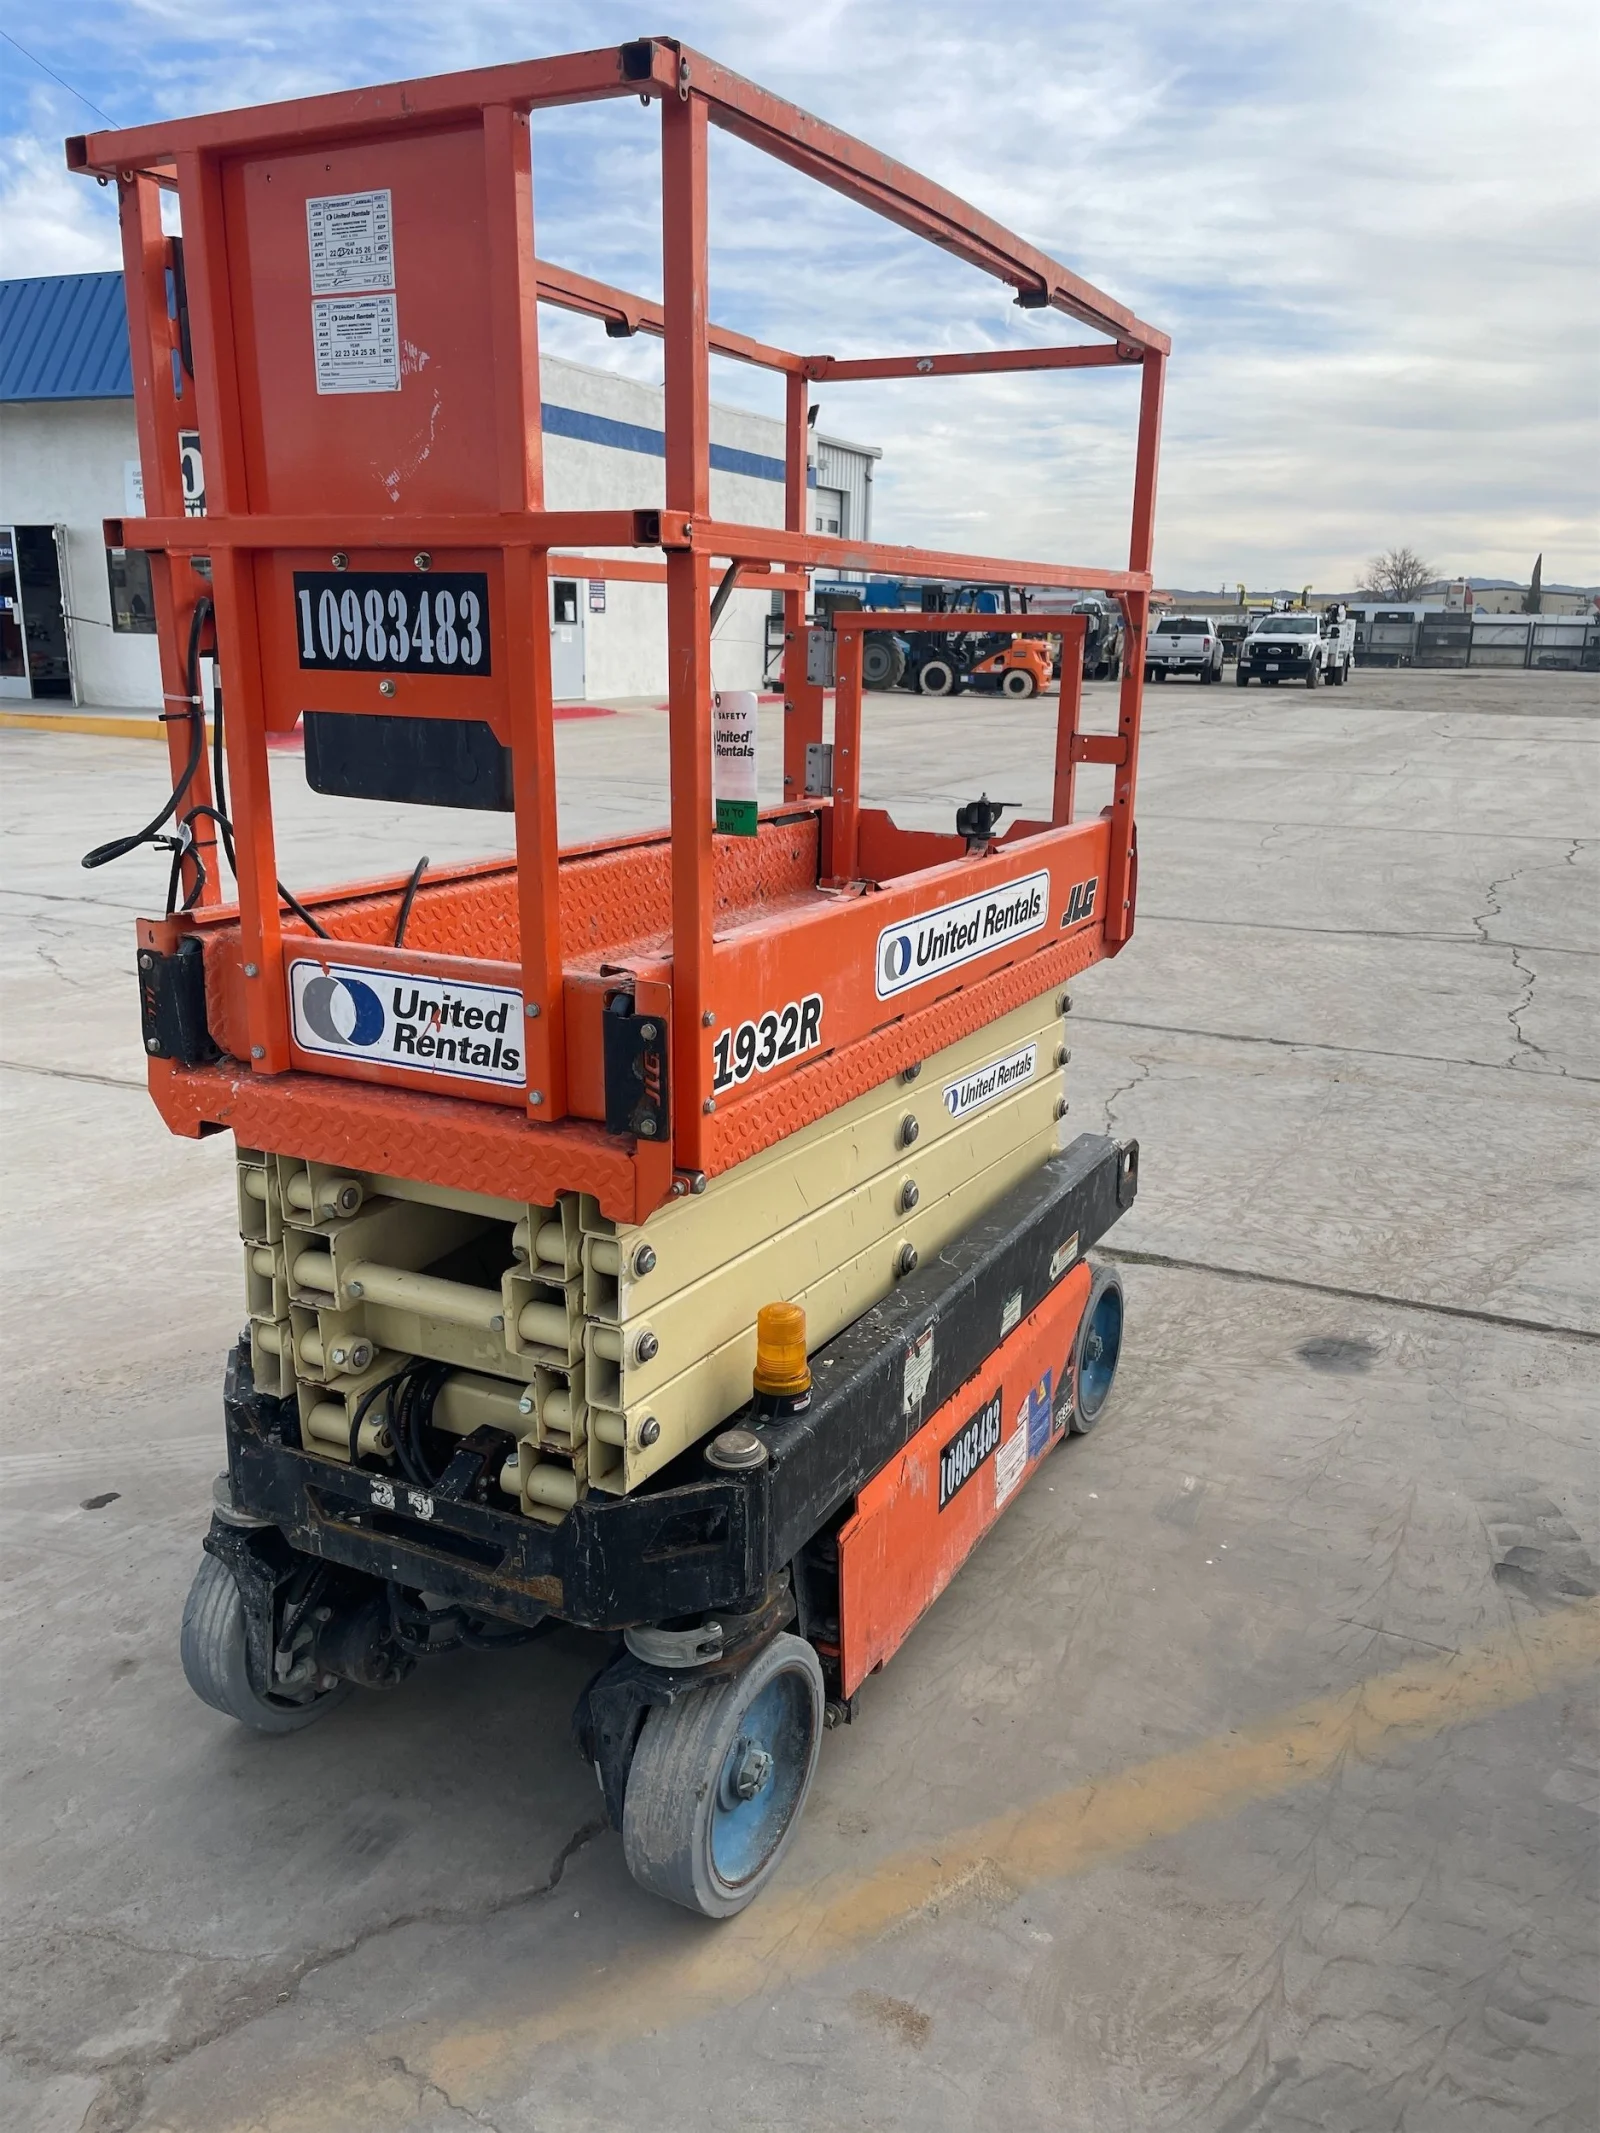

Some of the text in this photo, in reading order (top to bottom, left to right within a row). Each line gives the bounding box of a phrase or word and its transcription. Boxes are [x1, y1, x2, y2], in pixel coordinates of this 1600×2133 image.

[298, 588, 482, 666] 10983483
[716, 730, 749, 743] United
[718, 712, 747, 720] SAFETY
[716, 746, 754, 758] Rentals
[1062, 877, 1098, 927] JLG
[917, 888, 1042, 968] United Rentals
[393, 987, 509, 1033] United
[393, 1022, 520, 1071] Rentals
[713, 994, 823, 1092] 1932R
[960, 1054, 1032, 1108] United Rentals
[940, 1399, 1000, 1506] 10983483
